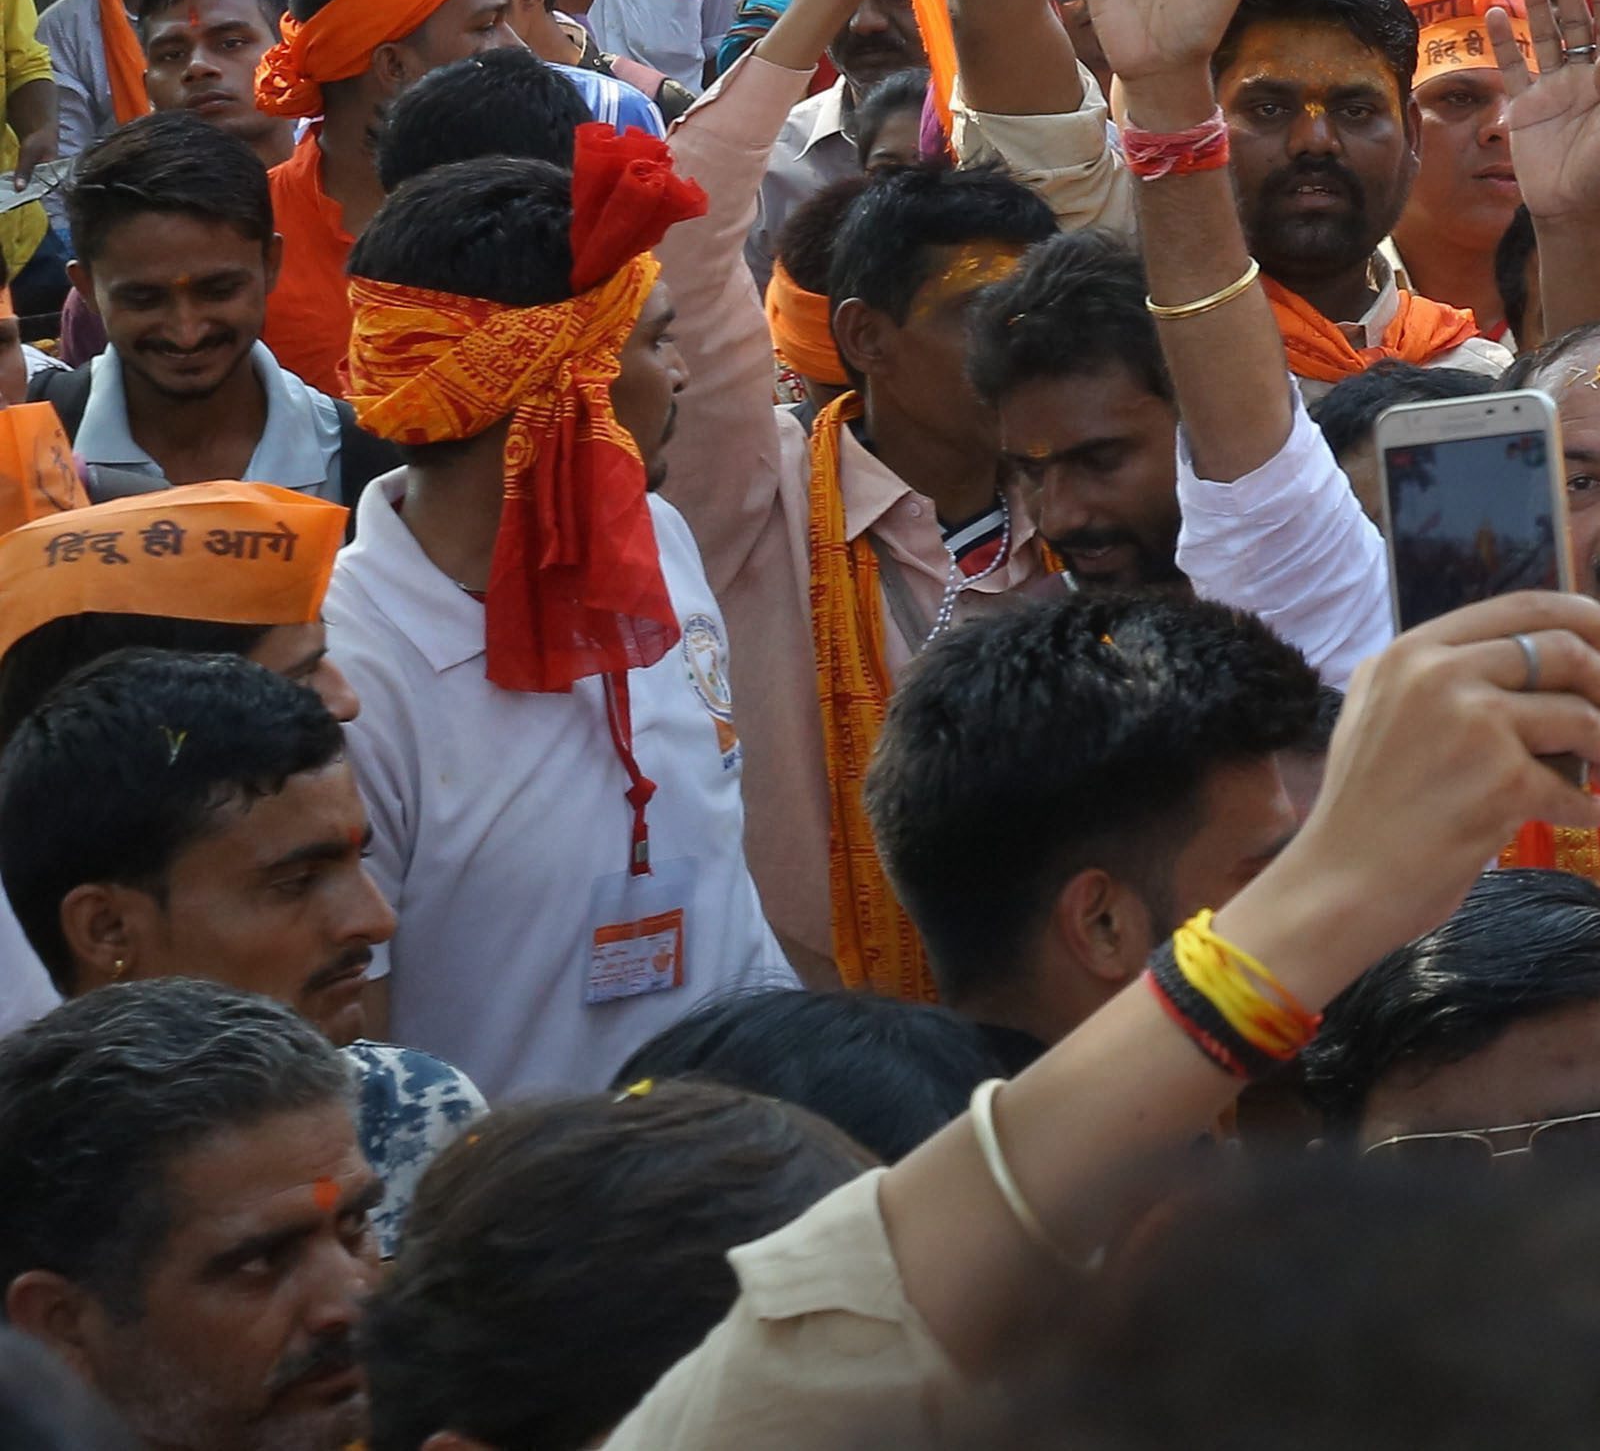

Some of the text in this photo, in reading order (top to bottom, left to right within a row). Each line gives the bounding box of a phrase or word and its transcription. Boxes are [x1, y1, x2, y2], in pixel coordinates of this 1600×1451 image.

[1424, 38, 1463, 66] हिंदू
[1462, 29, 1485, 57] ही
[45, 519, 299, 567] हिंदू ही आगे
